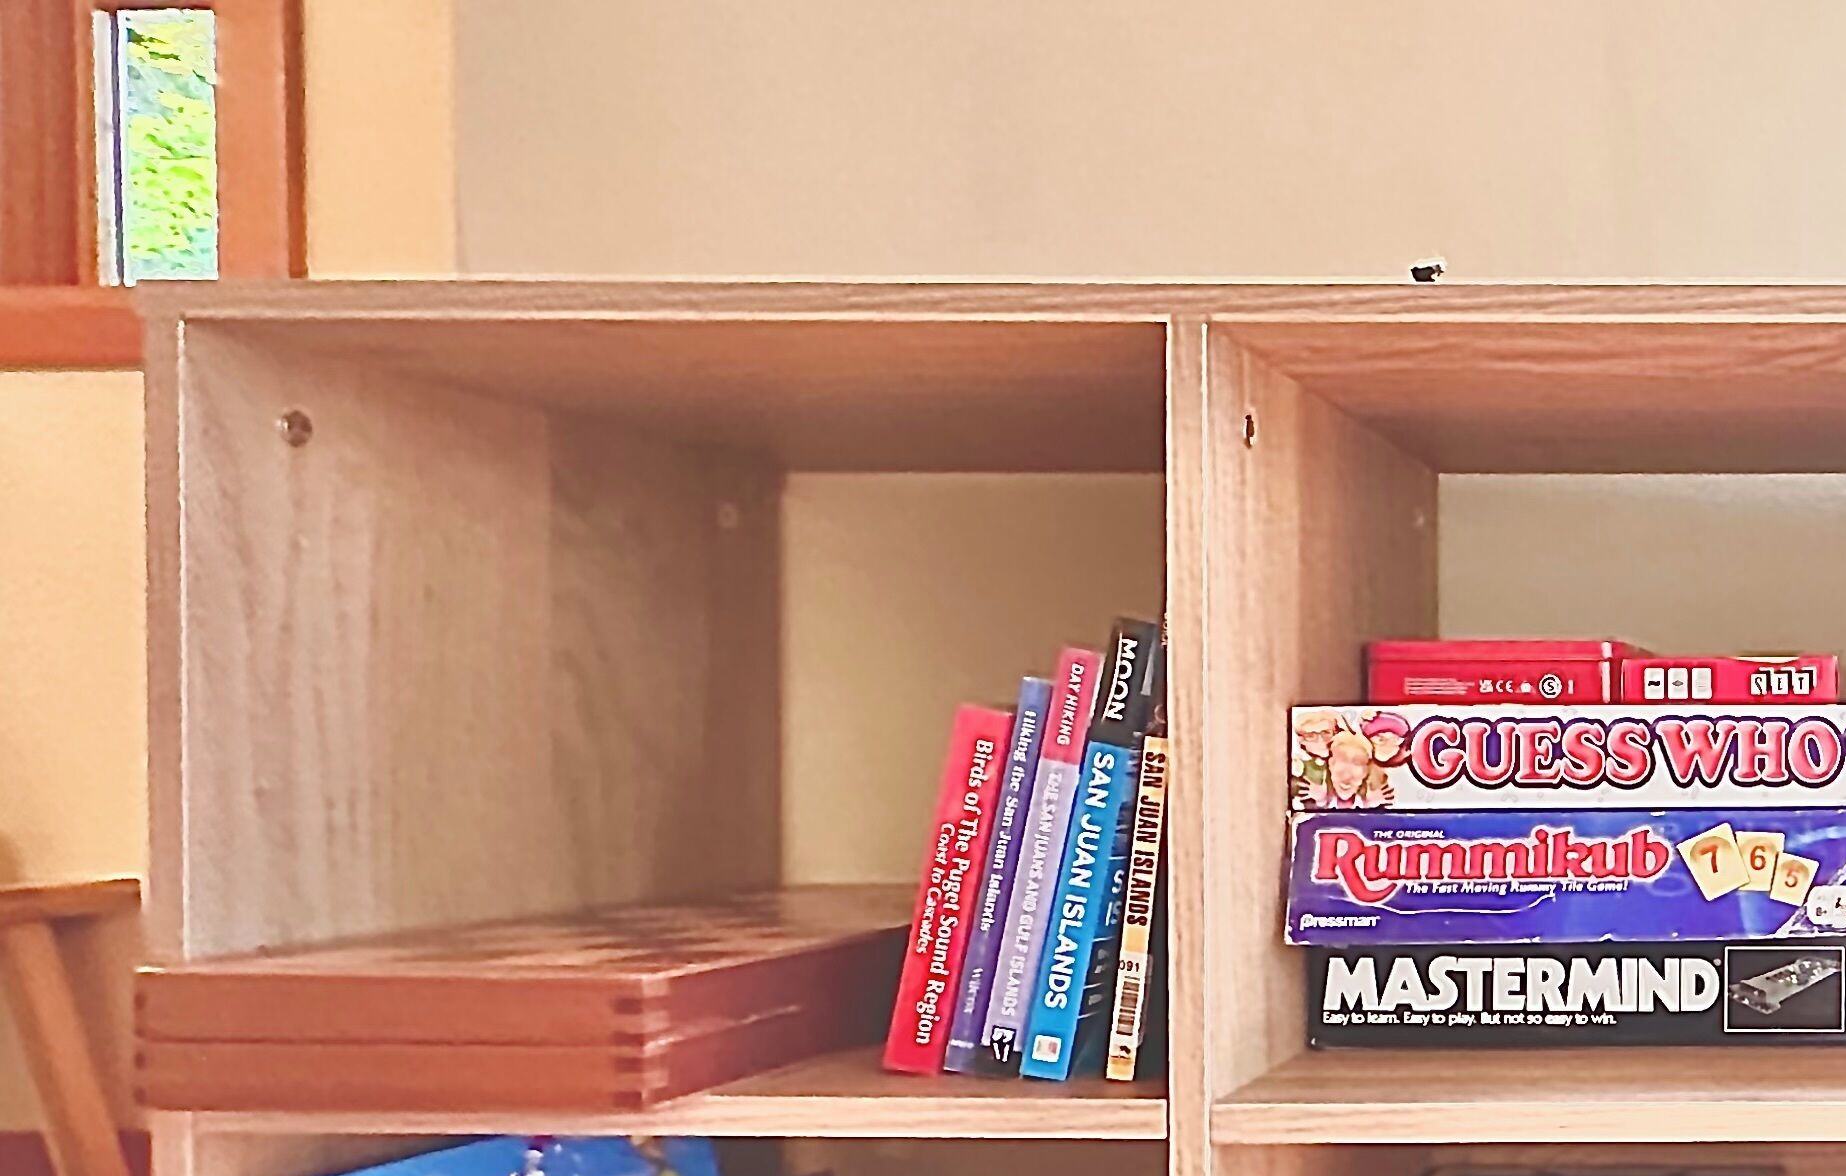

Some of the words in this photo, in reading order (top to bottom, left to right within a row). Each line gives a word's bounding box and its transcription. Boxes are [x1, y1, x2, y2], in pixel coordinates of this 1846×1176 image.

[1067, 663, 1087, 693] DAY
[1105, 638, 1138, 721] MOON
[1013, 709, 1038, 763] Hiking
[1056, 693, 1080, 746] HIKING
[968, 738, 996, 789] Birds
[1143, 751, 1166, 789] SAN
[1409, 720, 1653, 785] GUESS
[1008, 765, 1026, 792] the
[1044, 772, 1064, 801] THE
[1085, 751, 1116, 808] SAN
[963, 791, 985, 815] of
[1001, 795, 1020, 829] San
[1038, 804, 1058, 833] SAN
[1136, 795, 1161, 843] JUAN
[934, 822, 957, 865] Coast
[955, 815, 980, 855] The
[993, 829, 1013, 870] Juan
[1027, 833, 1052, 880] JUANS
[1069, 812, 1104, 889] JUAN
[1750, 845, 1766, 871] 6
[1314, 828, 1671, 903] Rummikub
[1700, 844, 1719, 874] 7
[1784, 863, 1801, 888] 5
[937, 855, 972, 911] Puget
[981, 872, 1003, 932] Islands
[1023, 881, 1042, 912] AND
[1127, 849, 1155, 926] ISLANDS
[1406, 882, 1428, 894] The
[1432, 881, 1457, 893] Fast
[1461, 881, 1506, 895] Moving
[1560, 881, 1583, 892] Tile
[1587, 881, 1629, 892] Game!
[916, 886, 942, 955] Cascades
[929, 914, 959, 974] Sound
[1013, 914, 1035, 953] GULF
[1047, 893, 1089, 1010] ISLANDS
[1000, 955, 1027, 1017] ISLANDS
[1323, 955, 1720, 1012] MASTERMIND
[915, 980, 945, 1045] Region
[1323, 1012, 1350, 1026] Easy
[1351, 1012, 1365, 1024] to
[1432, 1012, 1446, 1024] to
[1503, 1012, 1525, 1024] not
[1527, 1012, 1542, 1024] so
[1575, 1012, 1589, 1024] to
